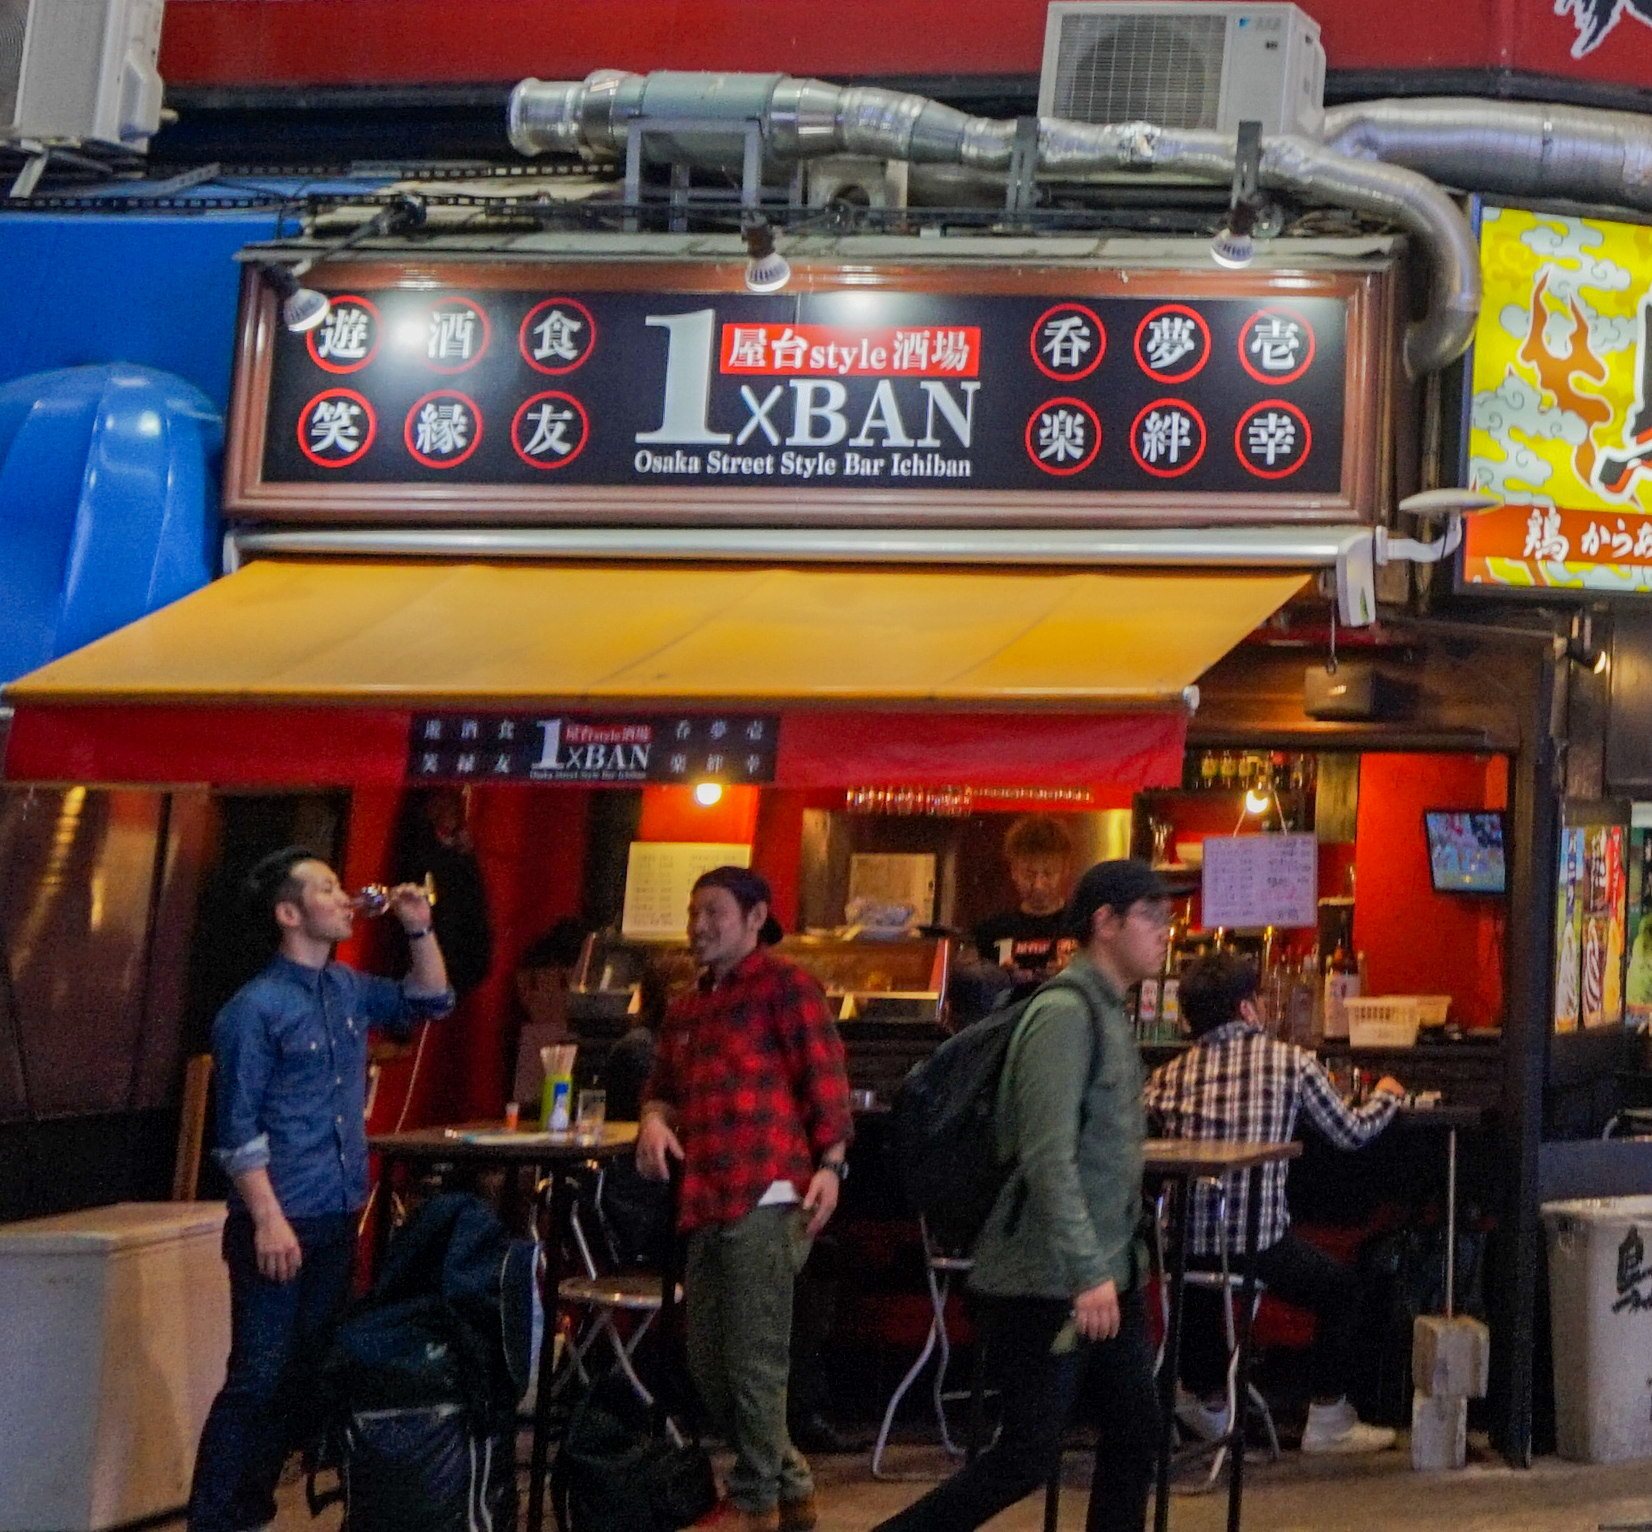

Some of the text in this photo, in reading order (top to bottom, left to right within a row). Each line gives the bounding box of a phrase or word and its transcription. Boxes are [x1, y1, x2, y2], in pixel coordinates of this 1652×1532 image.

[319, 309, 582, 361] 遊 酒 食
[728, 327, 970, 374] 屋台style酒場
[1042, 315, 1301, 371] 呑 夢 壱
[310, 401, 573, 456] 笑 縁 友
[1039, 409, 1297, 466] 楽 絆 幸
[634, 450, 972, 478] Osaka Street Style Bar Ichiban
